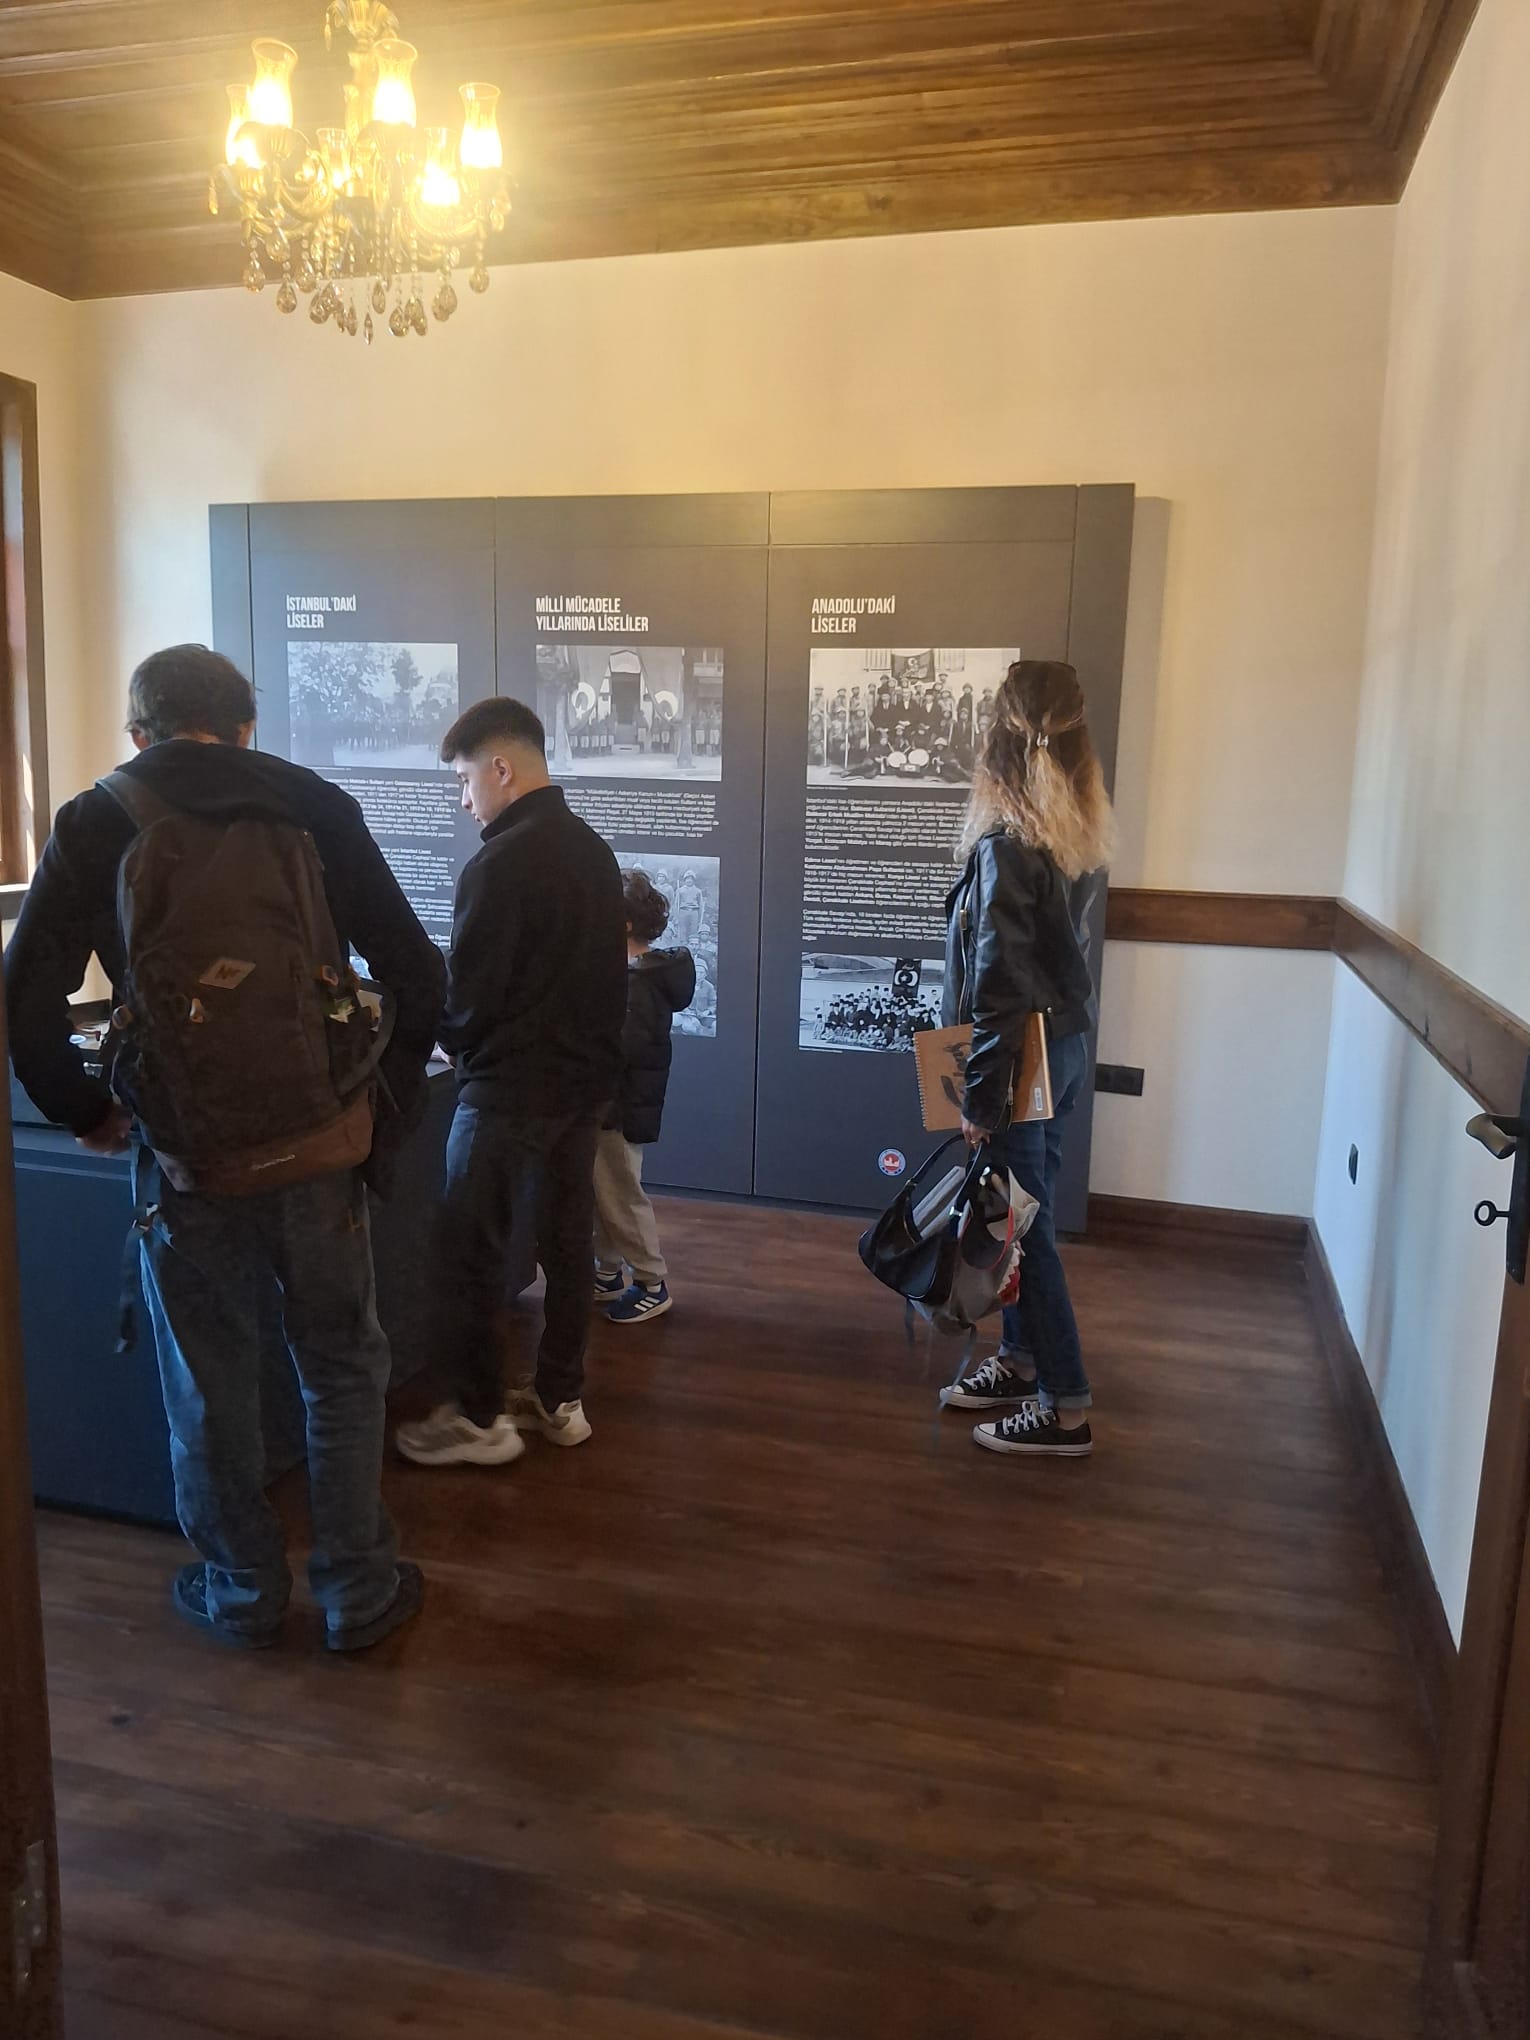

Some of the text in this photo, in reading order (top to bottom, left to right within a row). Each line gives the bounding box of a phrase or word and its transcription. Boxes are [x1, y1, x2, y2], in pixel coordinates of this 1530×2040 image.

[286, 594, 357, 611] İSTANBUL'DAKİ
[536, 595, 621, 614] MİLLİ MÜCADELE
[811, 595, 896, 614] ANADOLU'DAKİ
[286, 613, 325, 629] LİSELER
[536, 614, 650, 633] YILLARINDA LİSELİLER
[811, 615, 857, 634] LİSELER
